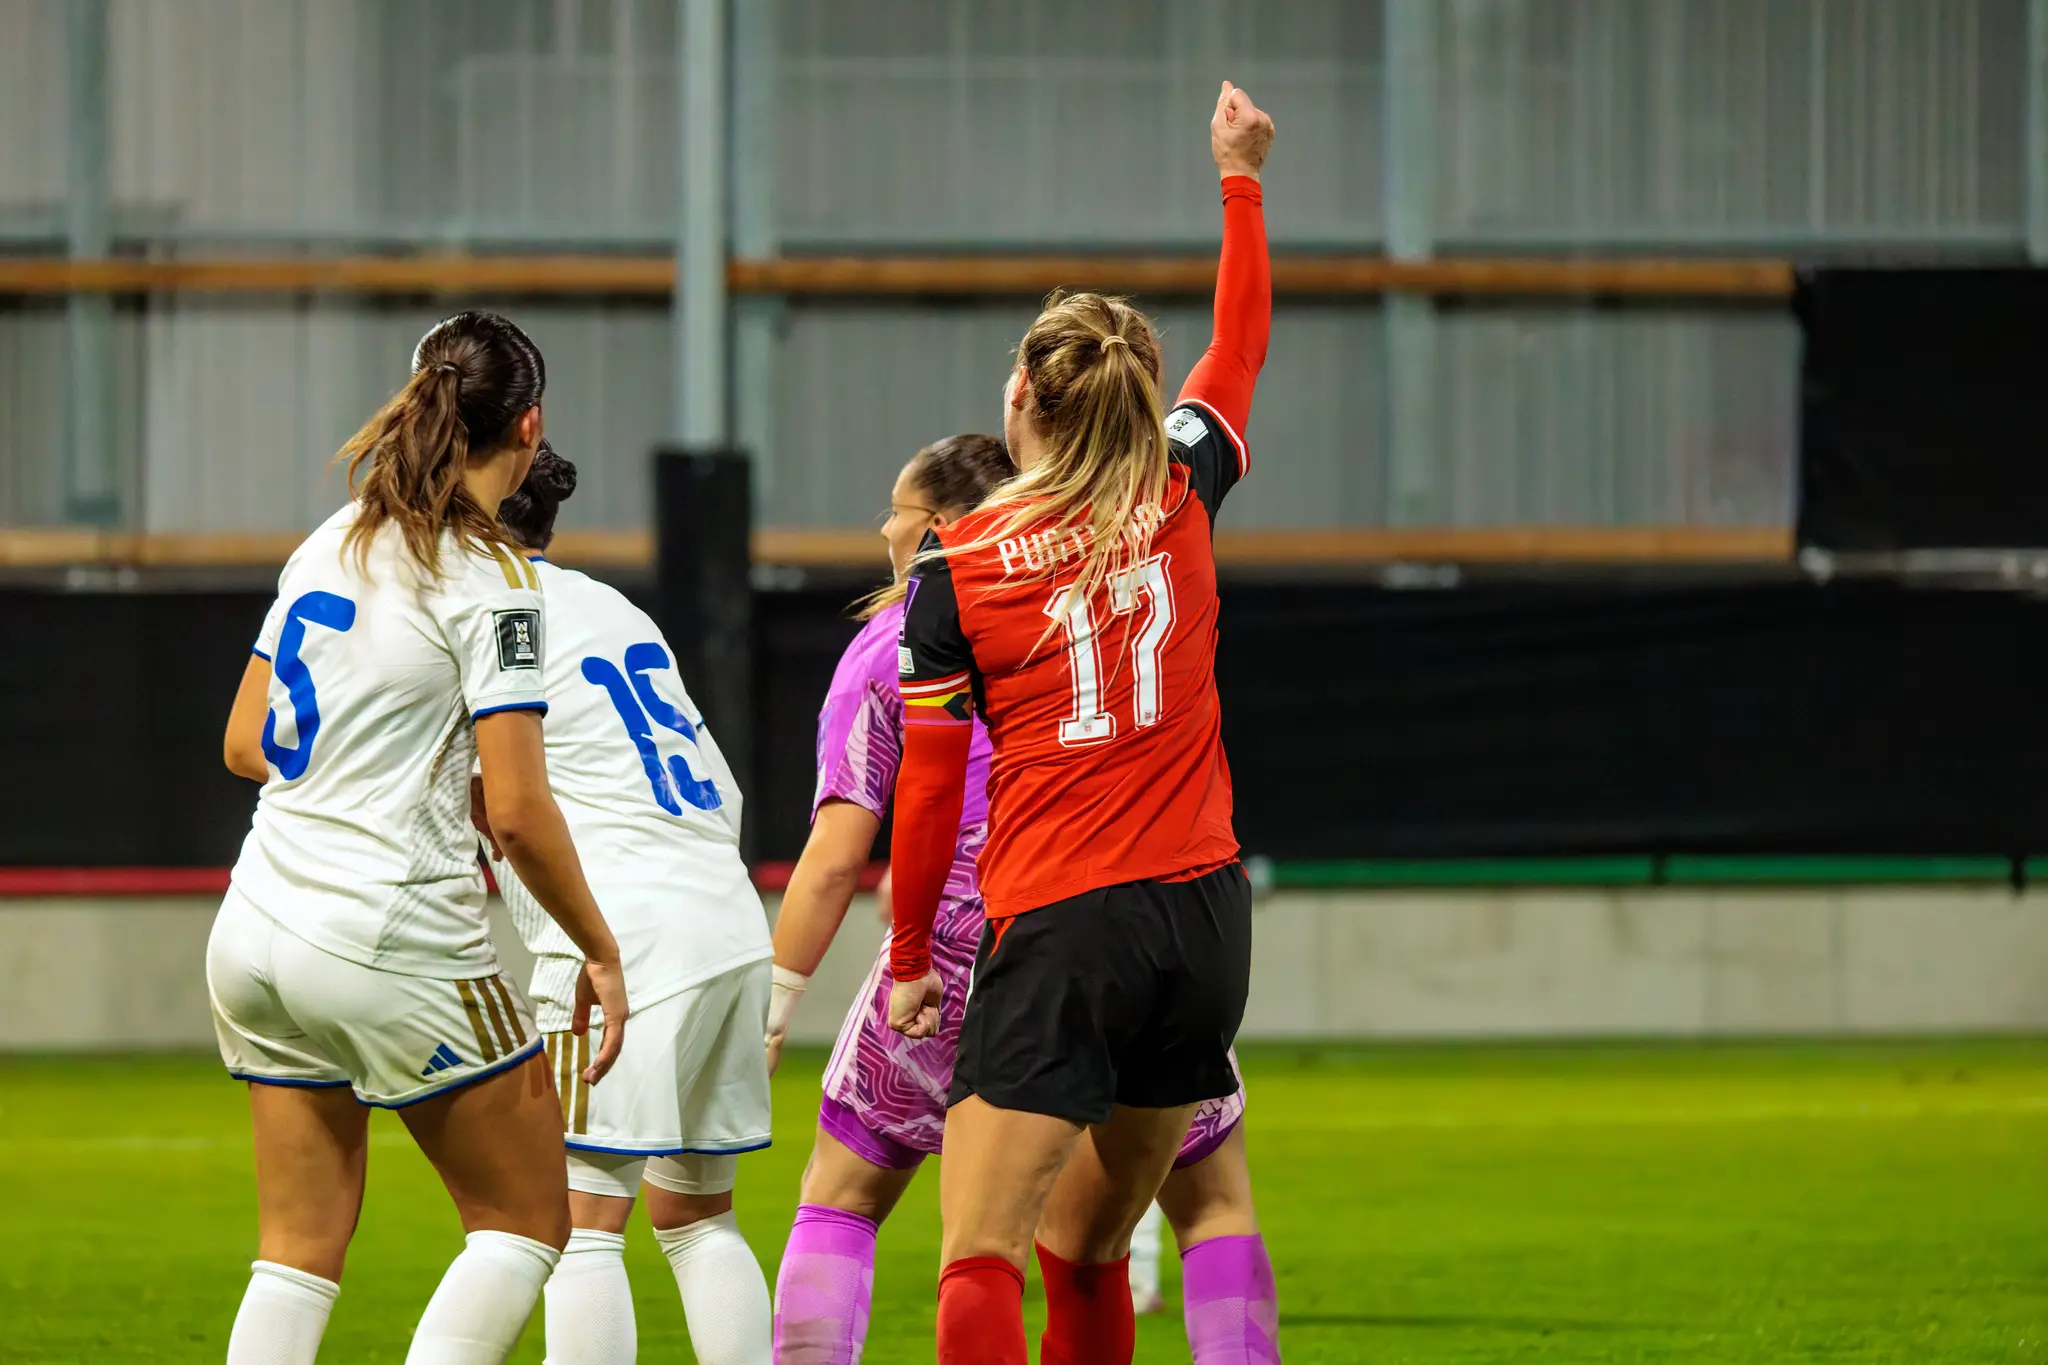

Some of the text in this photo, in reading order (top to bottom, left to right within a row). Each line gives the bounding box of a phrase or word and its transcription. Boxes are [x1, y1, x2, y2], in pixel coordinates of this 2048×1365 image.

[260, 590, 356, 781] 5
[581, 642, 723, 817] 15
[1042, 552, 1177, 748] 17
